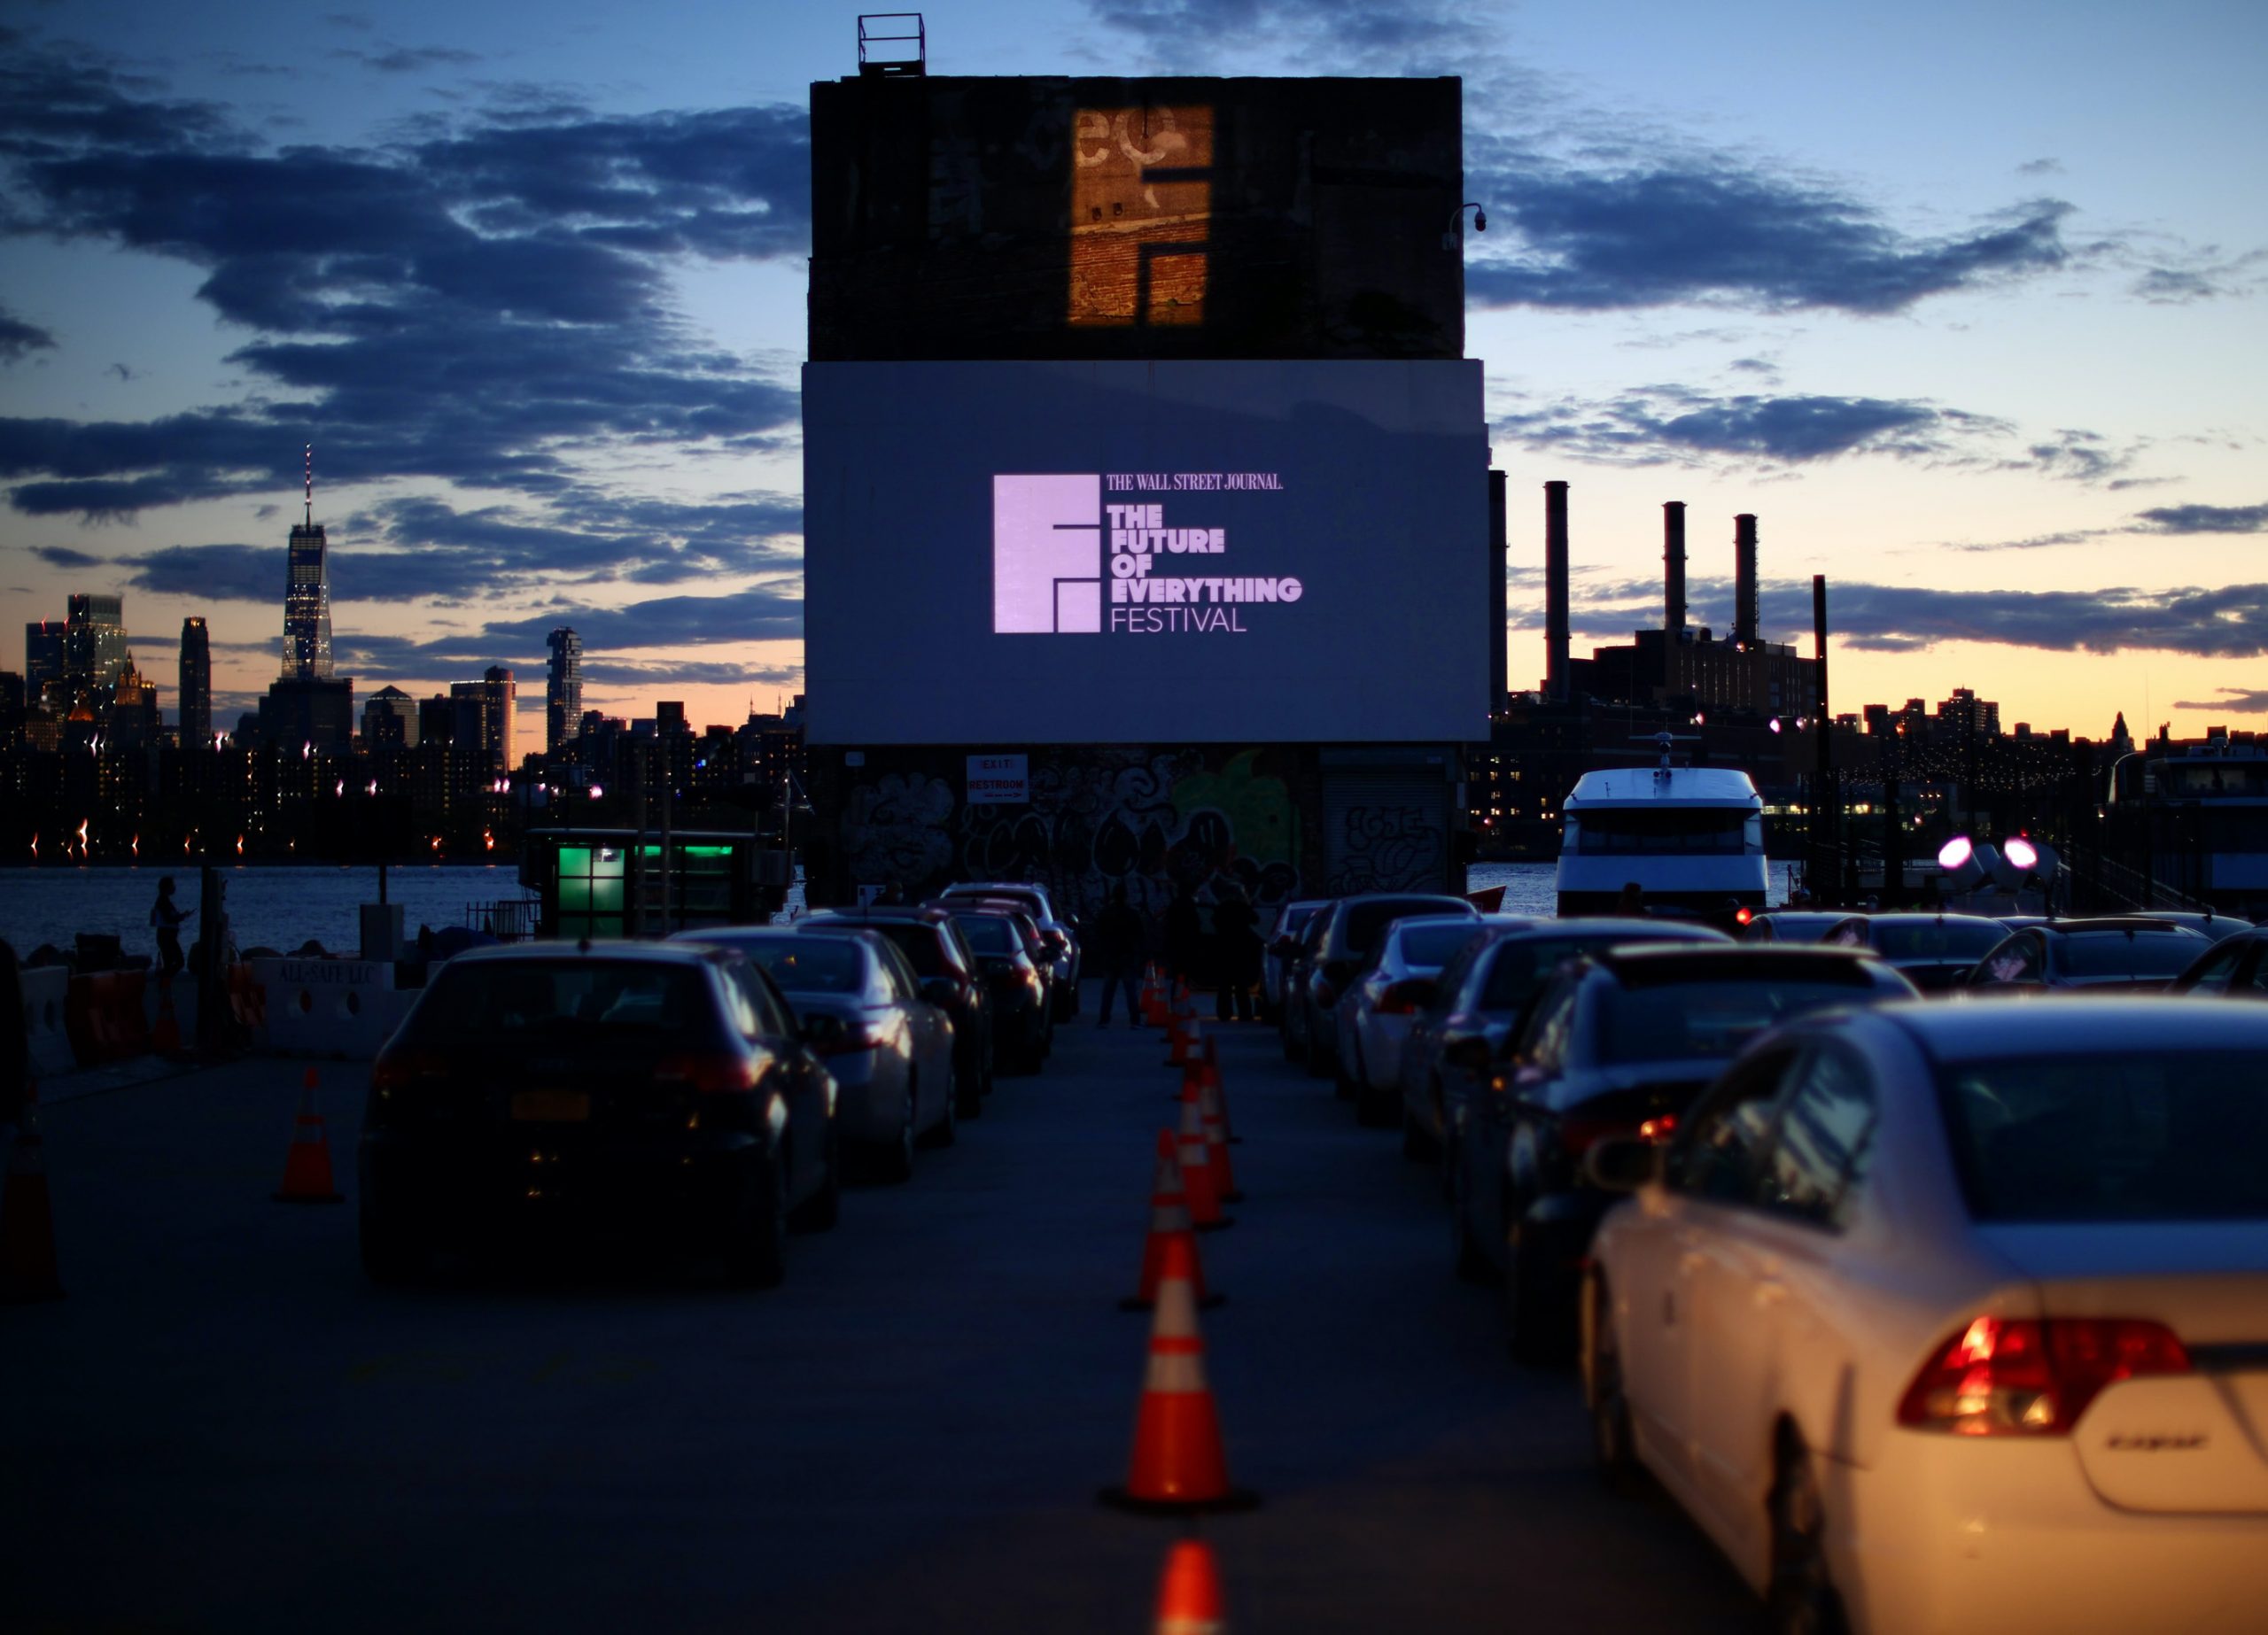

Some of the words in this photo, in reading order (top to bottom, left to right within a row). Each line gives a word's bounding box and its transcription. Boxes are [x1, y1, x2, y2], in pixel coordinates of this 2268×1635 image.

[1107, 474, 1133, 491] THE
[1137, 474, 1170, 491] WALL
[1174, 473, 1223, 490] STREET
[1224, 473, 1284, 490] JOURNAL.
[1107, 505, 1162, 529] THE
[1111, 529, 1225, 554] FUTURE
[1111, 554, 1152, 578] OF
[1111, 578, 1303, 603] EVERYTHING
[1111, 608, 1247, 632] FESTIVAL
[983, 759, 1010, 769] EXIT
[969, 780, 1023, 790] RESTROOM
